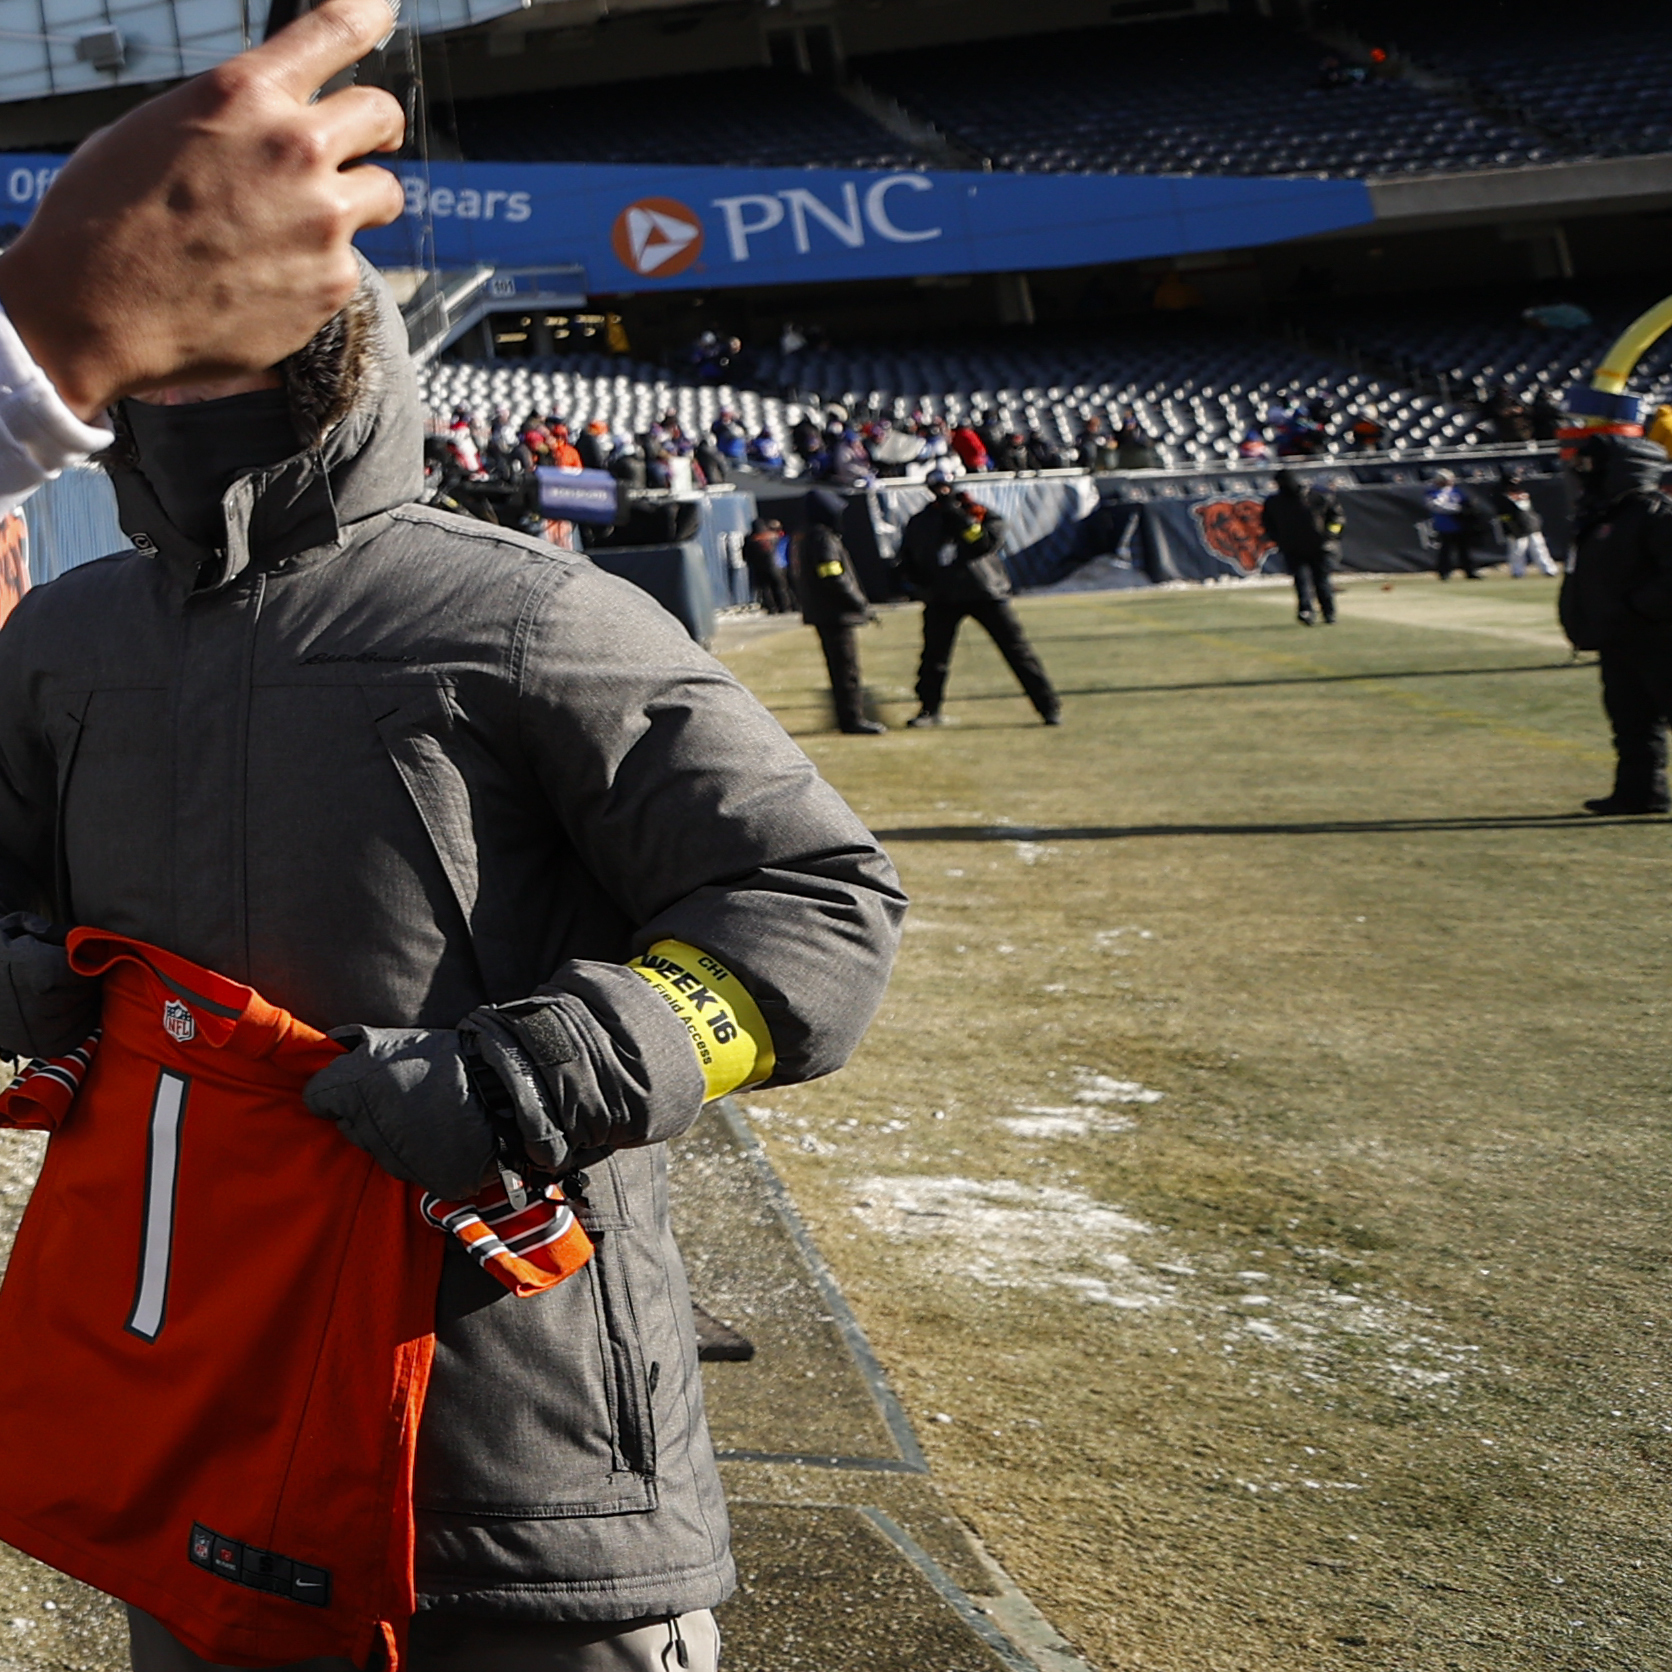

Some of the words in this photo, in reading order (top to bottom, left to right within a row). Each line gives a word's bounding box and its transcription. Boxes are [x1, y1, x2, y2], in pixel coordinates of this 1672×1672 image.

[404, 176, 533, 223] Bears
[710, 173, 943, 262] PNC
[641, 954, 719, 1014] WEEK
[706, 1009, 737, 1045] 16
[697, 957, 729, 981] CHI
[168, 1018, 190, 1036] NFL
[652, 983, 684, 1014] Field
[680, 1015, 712, 1066] Access
[124, 1065, 192, 1345] 1
